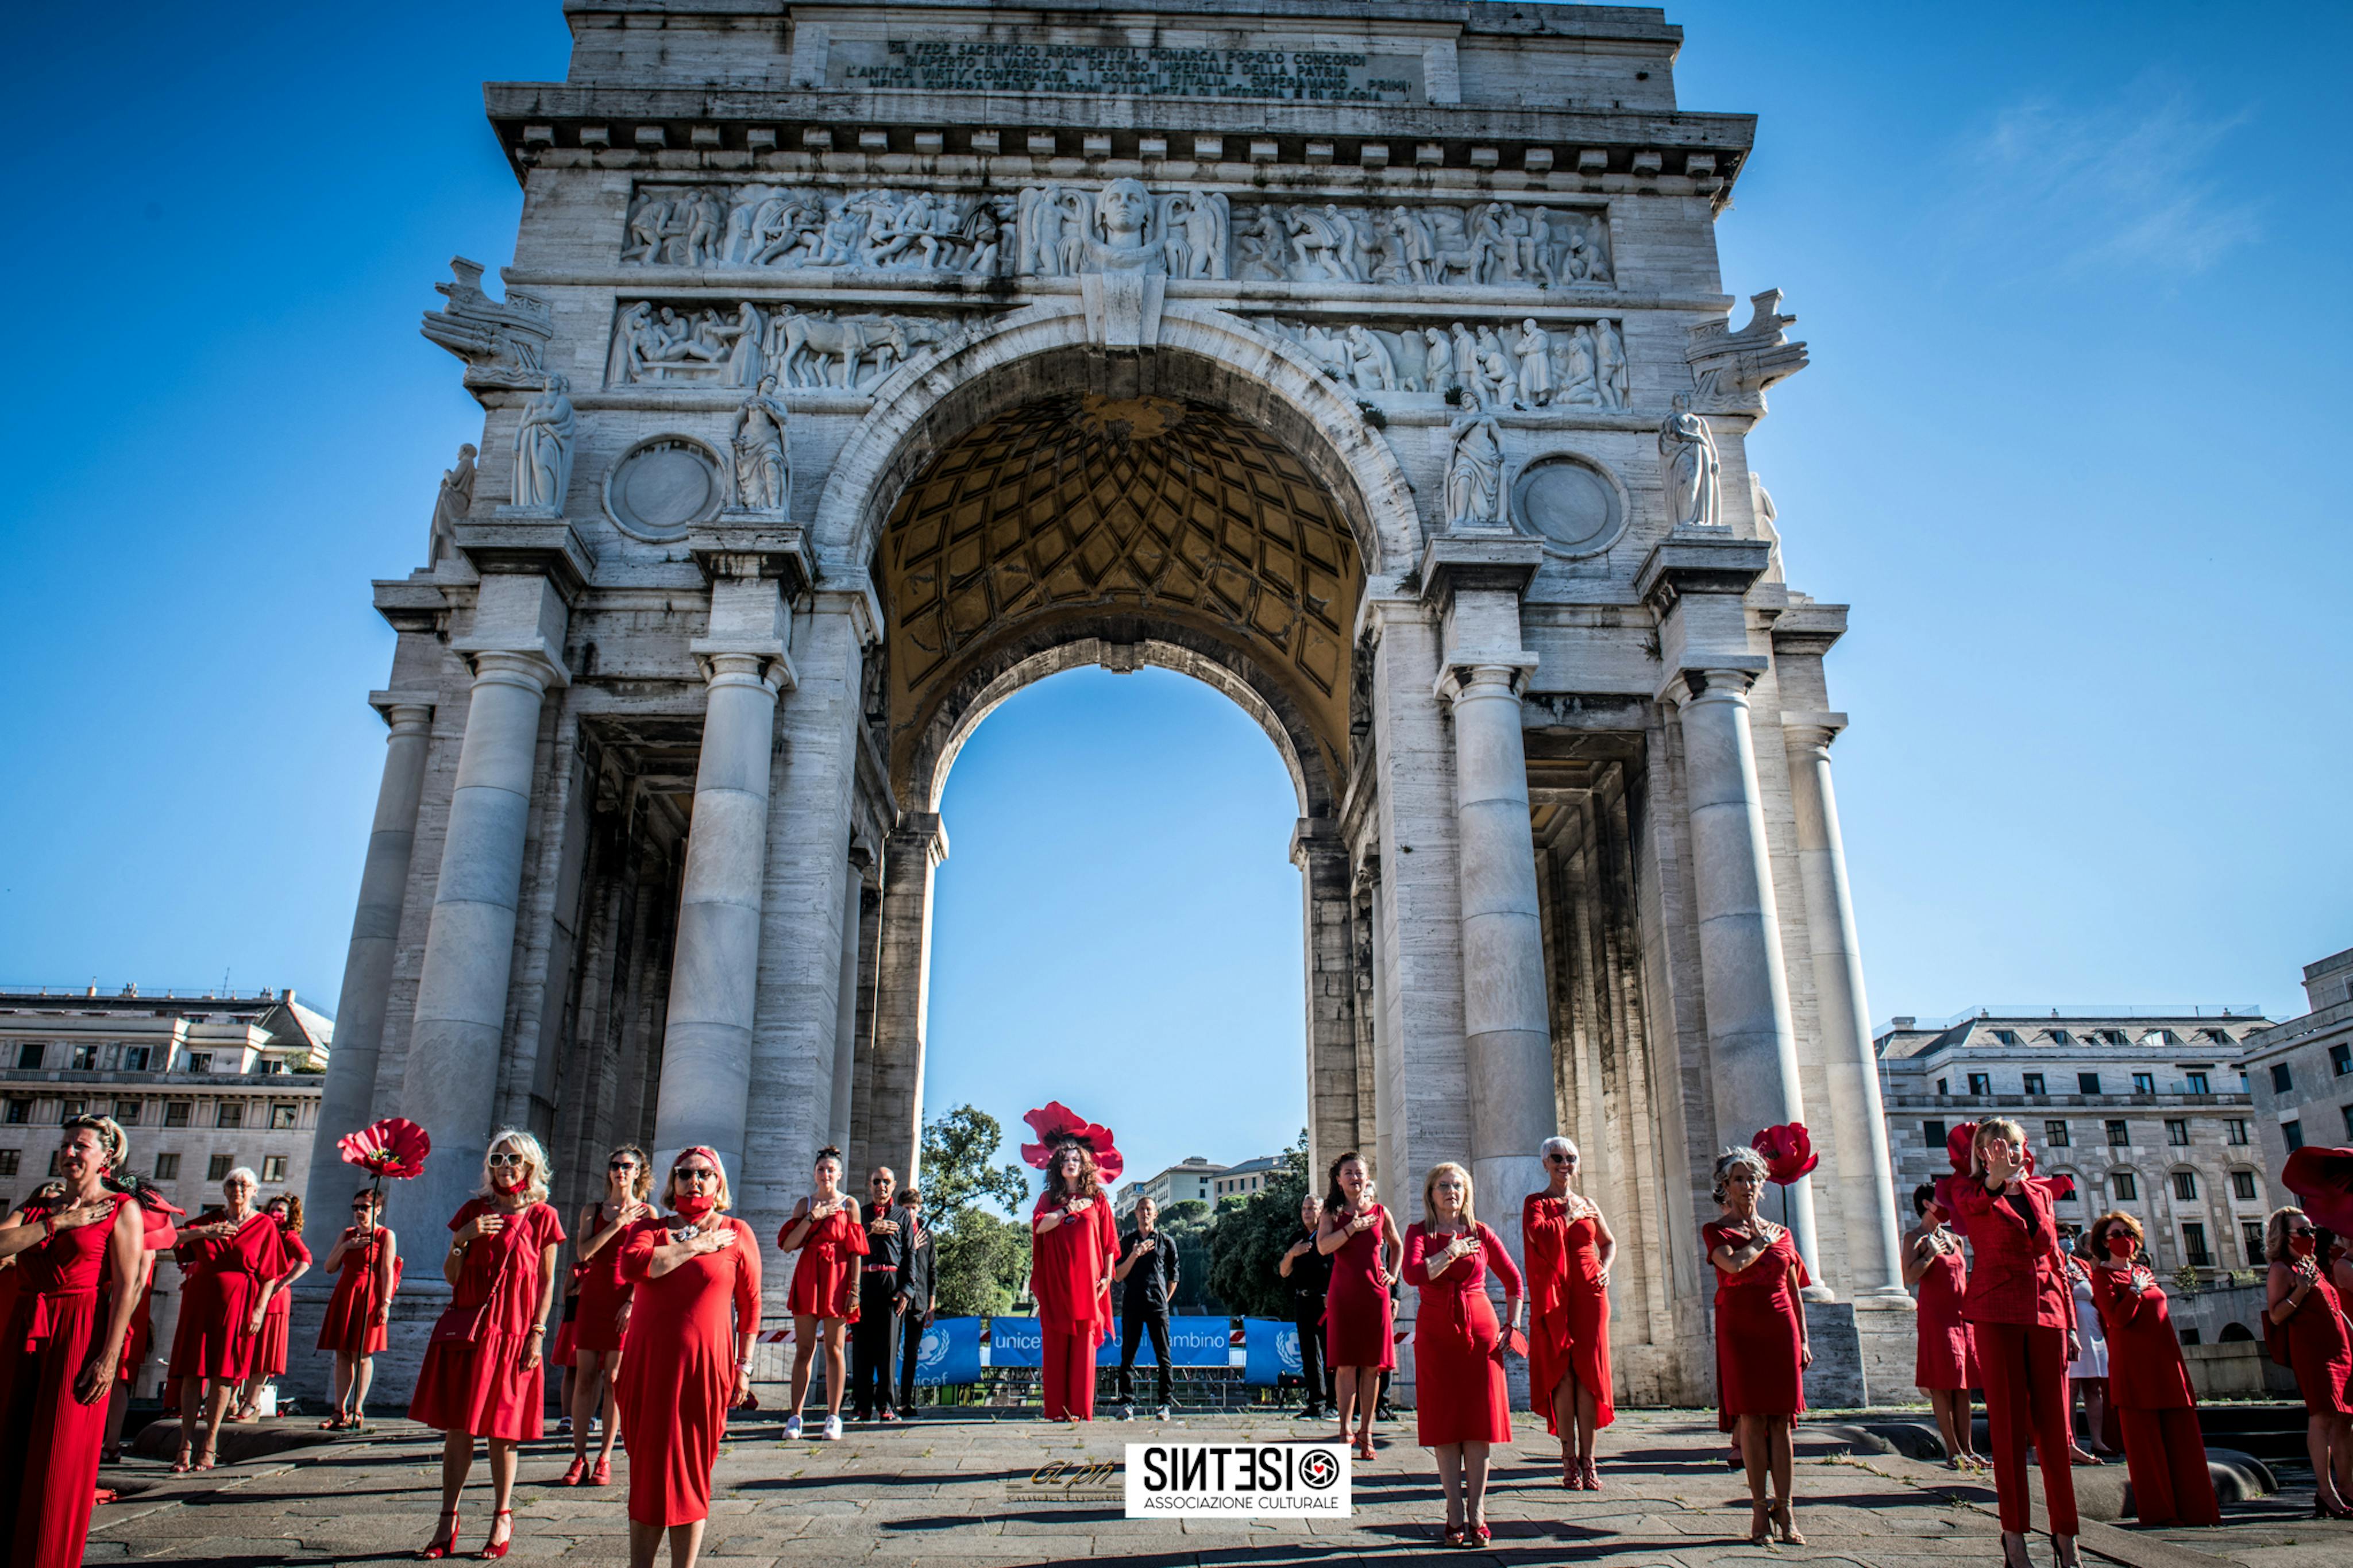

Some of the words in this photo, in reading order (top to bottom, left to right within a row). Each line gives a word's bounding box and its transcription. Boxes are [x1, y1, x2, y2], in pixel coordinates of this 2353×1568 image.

[915, 44, 950, 56] FEDE
[958, 44, 1038, 57] SACRIFICIO
[1046, 46, 1128, 60] ARDIMENTO
[1149, 49, 1218, 62] MONARCA
[1227, 51, 1284, 64] POPOLO
[1293, 53, 1365, 66] CONCORDI
[904, 56, 976, 67] RIAPERTO
[985, 57, 997, 68] IL
[1001, 57, 1050, 69] VARCO
[1059, 59, 1078, 70] AL
[1088, 60, 1150, 72] DESTINO
[1158, 62, 1233, 75] IMPERIALE
[1242, 64, 1287, 76] DELLA
[1297, 65, 1348, 78] PATRIA
[973, 69, 1068, 83] CONFERMATA
[1101, 72, 1161, 85] SOLDATI
[996, 1331, 1043, 1349] unice
[1168, 1332, 1224, 1348] ambino
